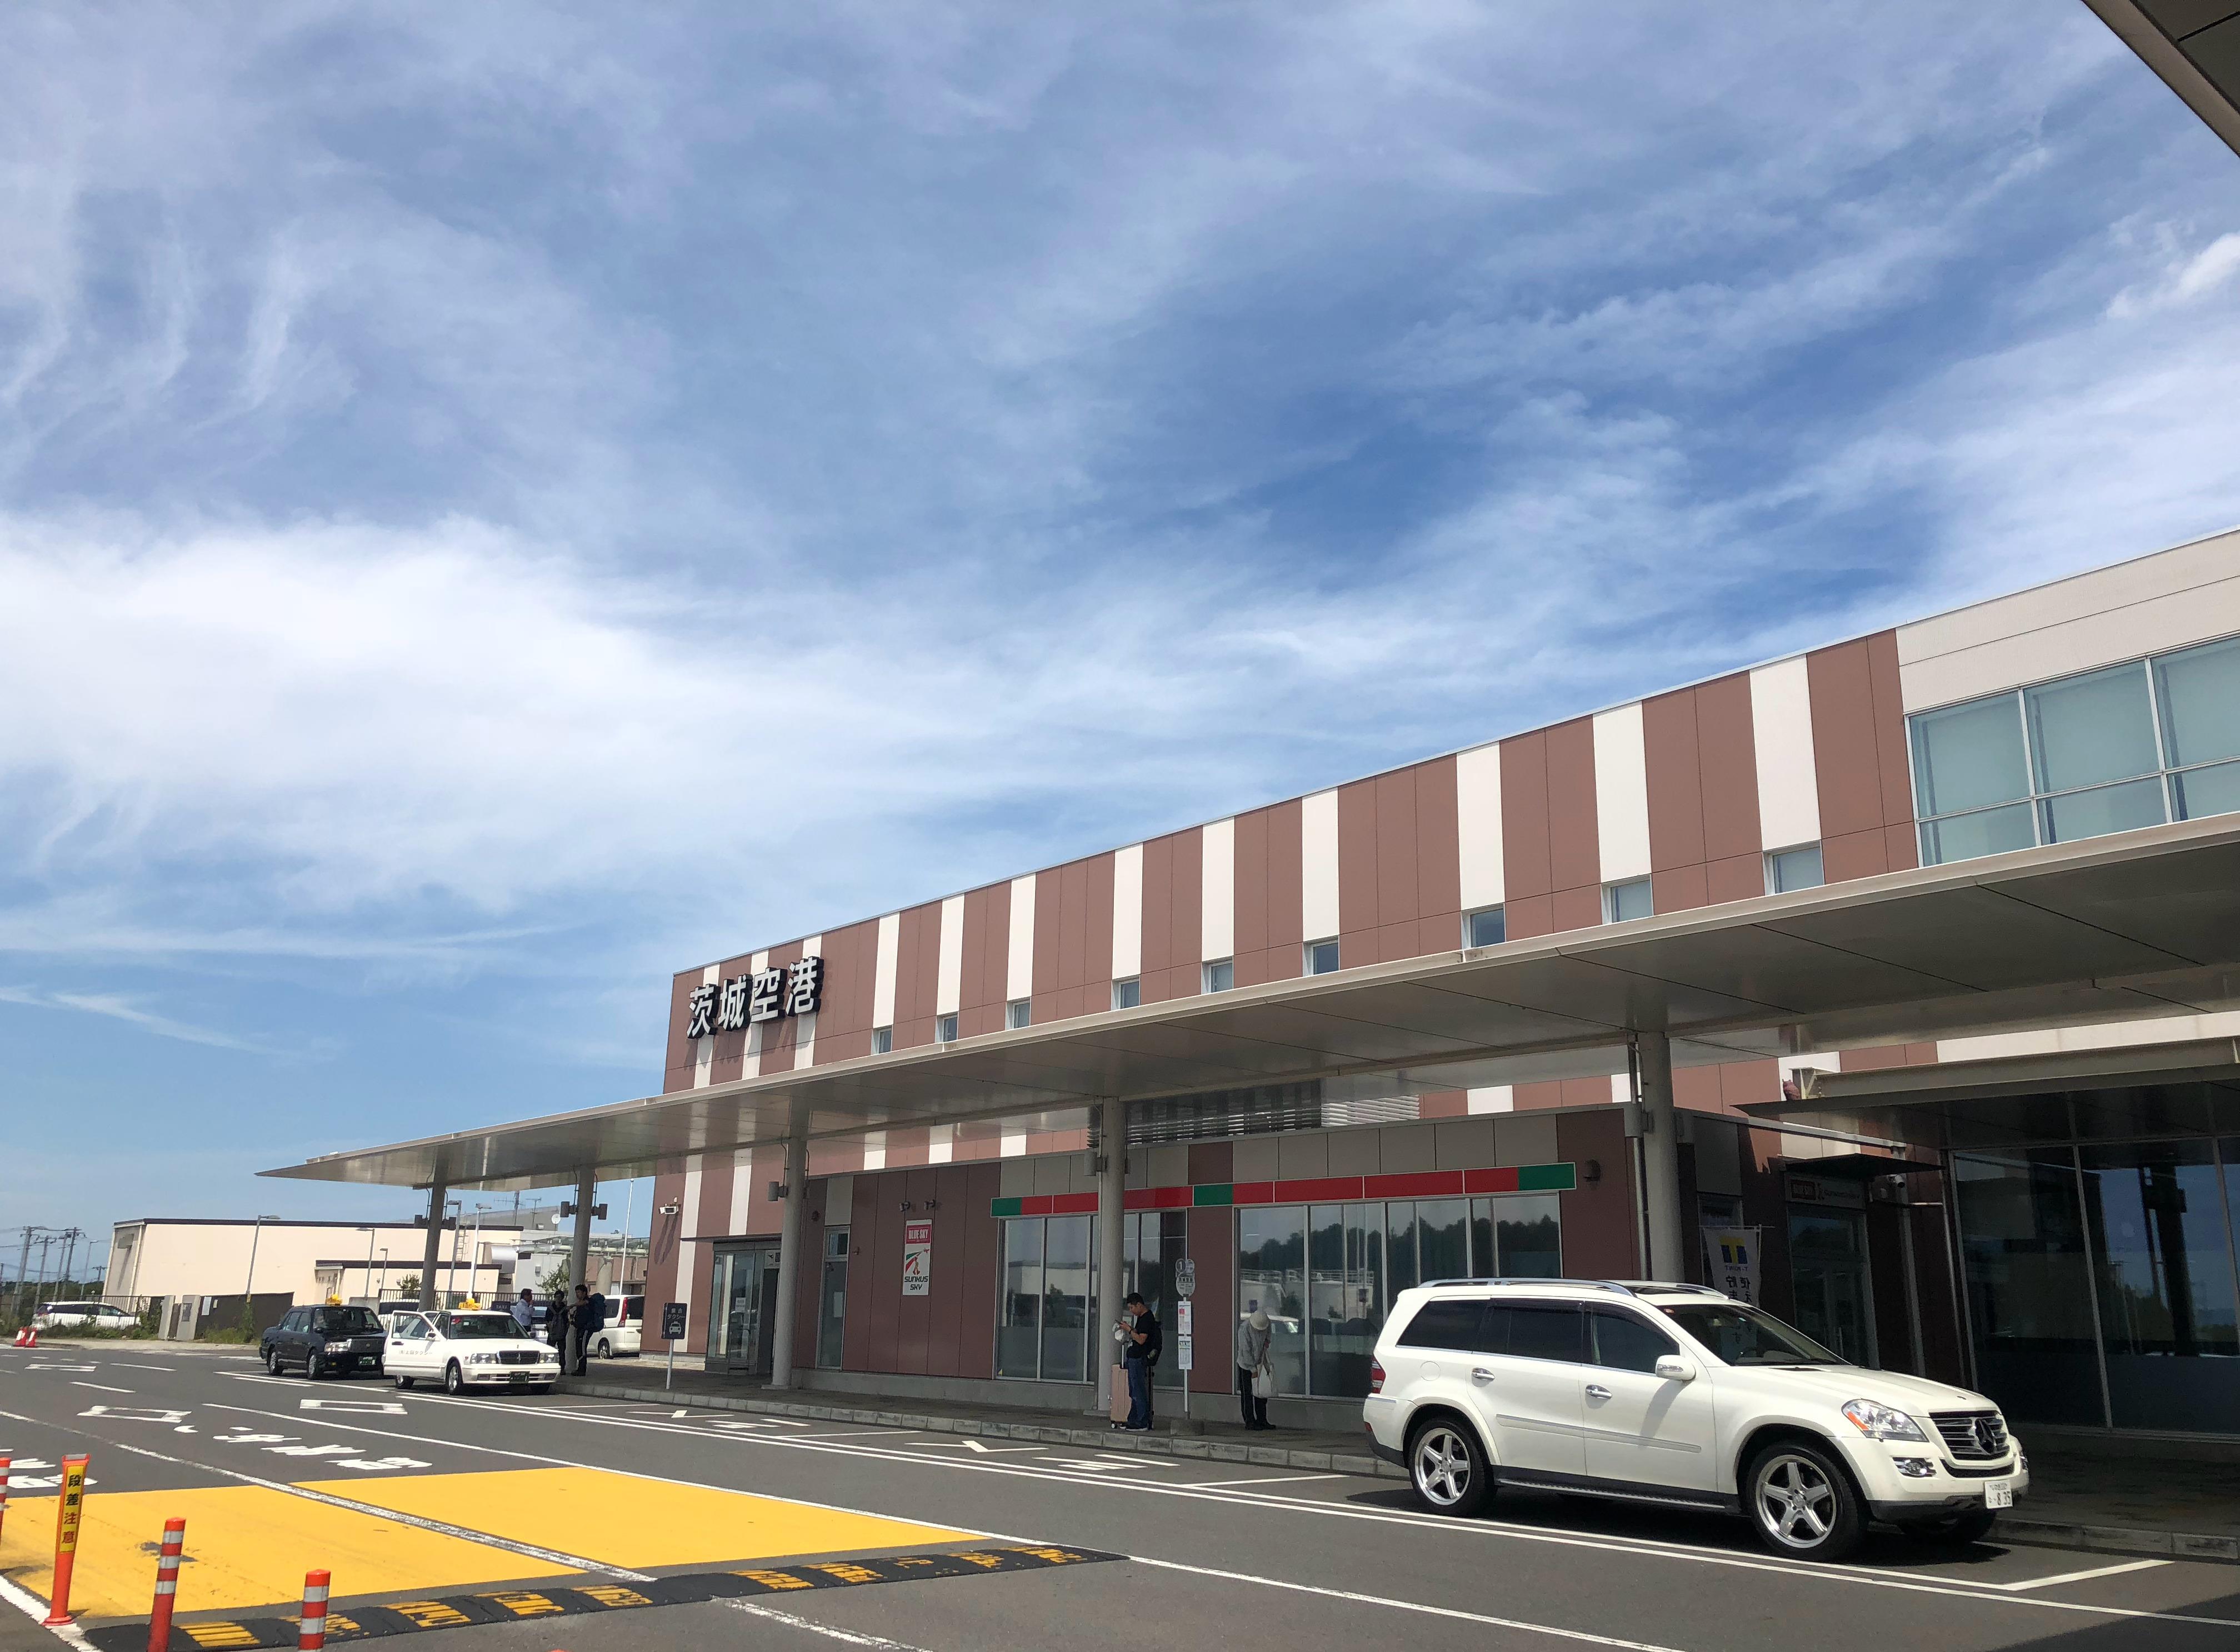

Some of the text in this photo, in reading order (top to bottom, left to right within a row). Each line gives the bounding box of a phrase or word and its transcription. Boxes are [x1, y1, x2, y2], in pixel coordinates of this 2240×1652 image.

[687, 956, 824, 1039] 茨城空港
[909, 1229, 928, 1239] BLUE SKY
[1179, 1261, 1182, 1270] 1
[61, 1474, 82, 1544] 段差注意
